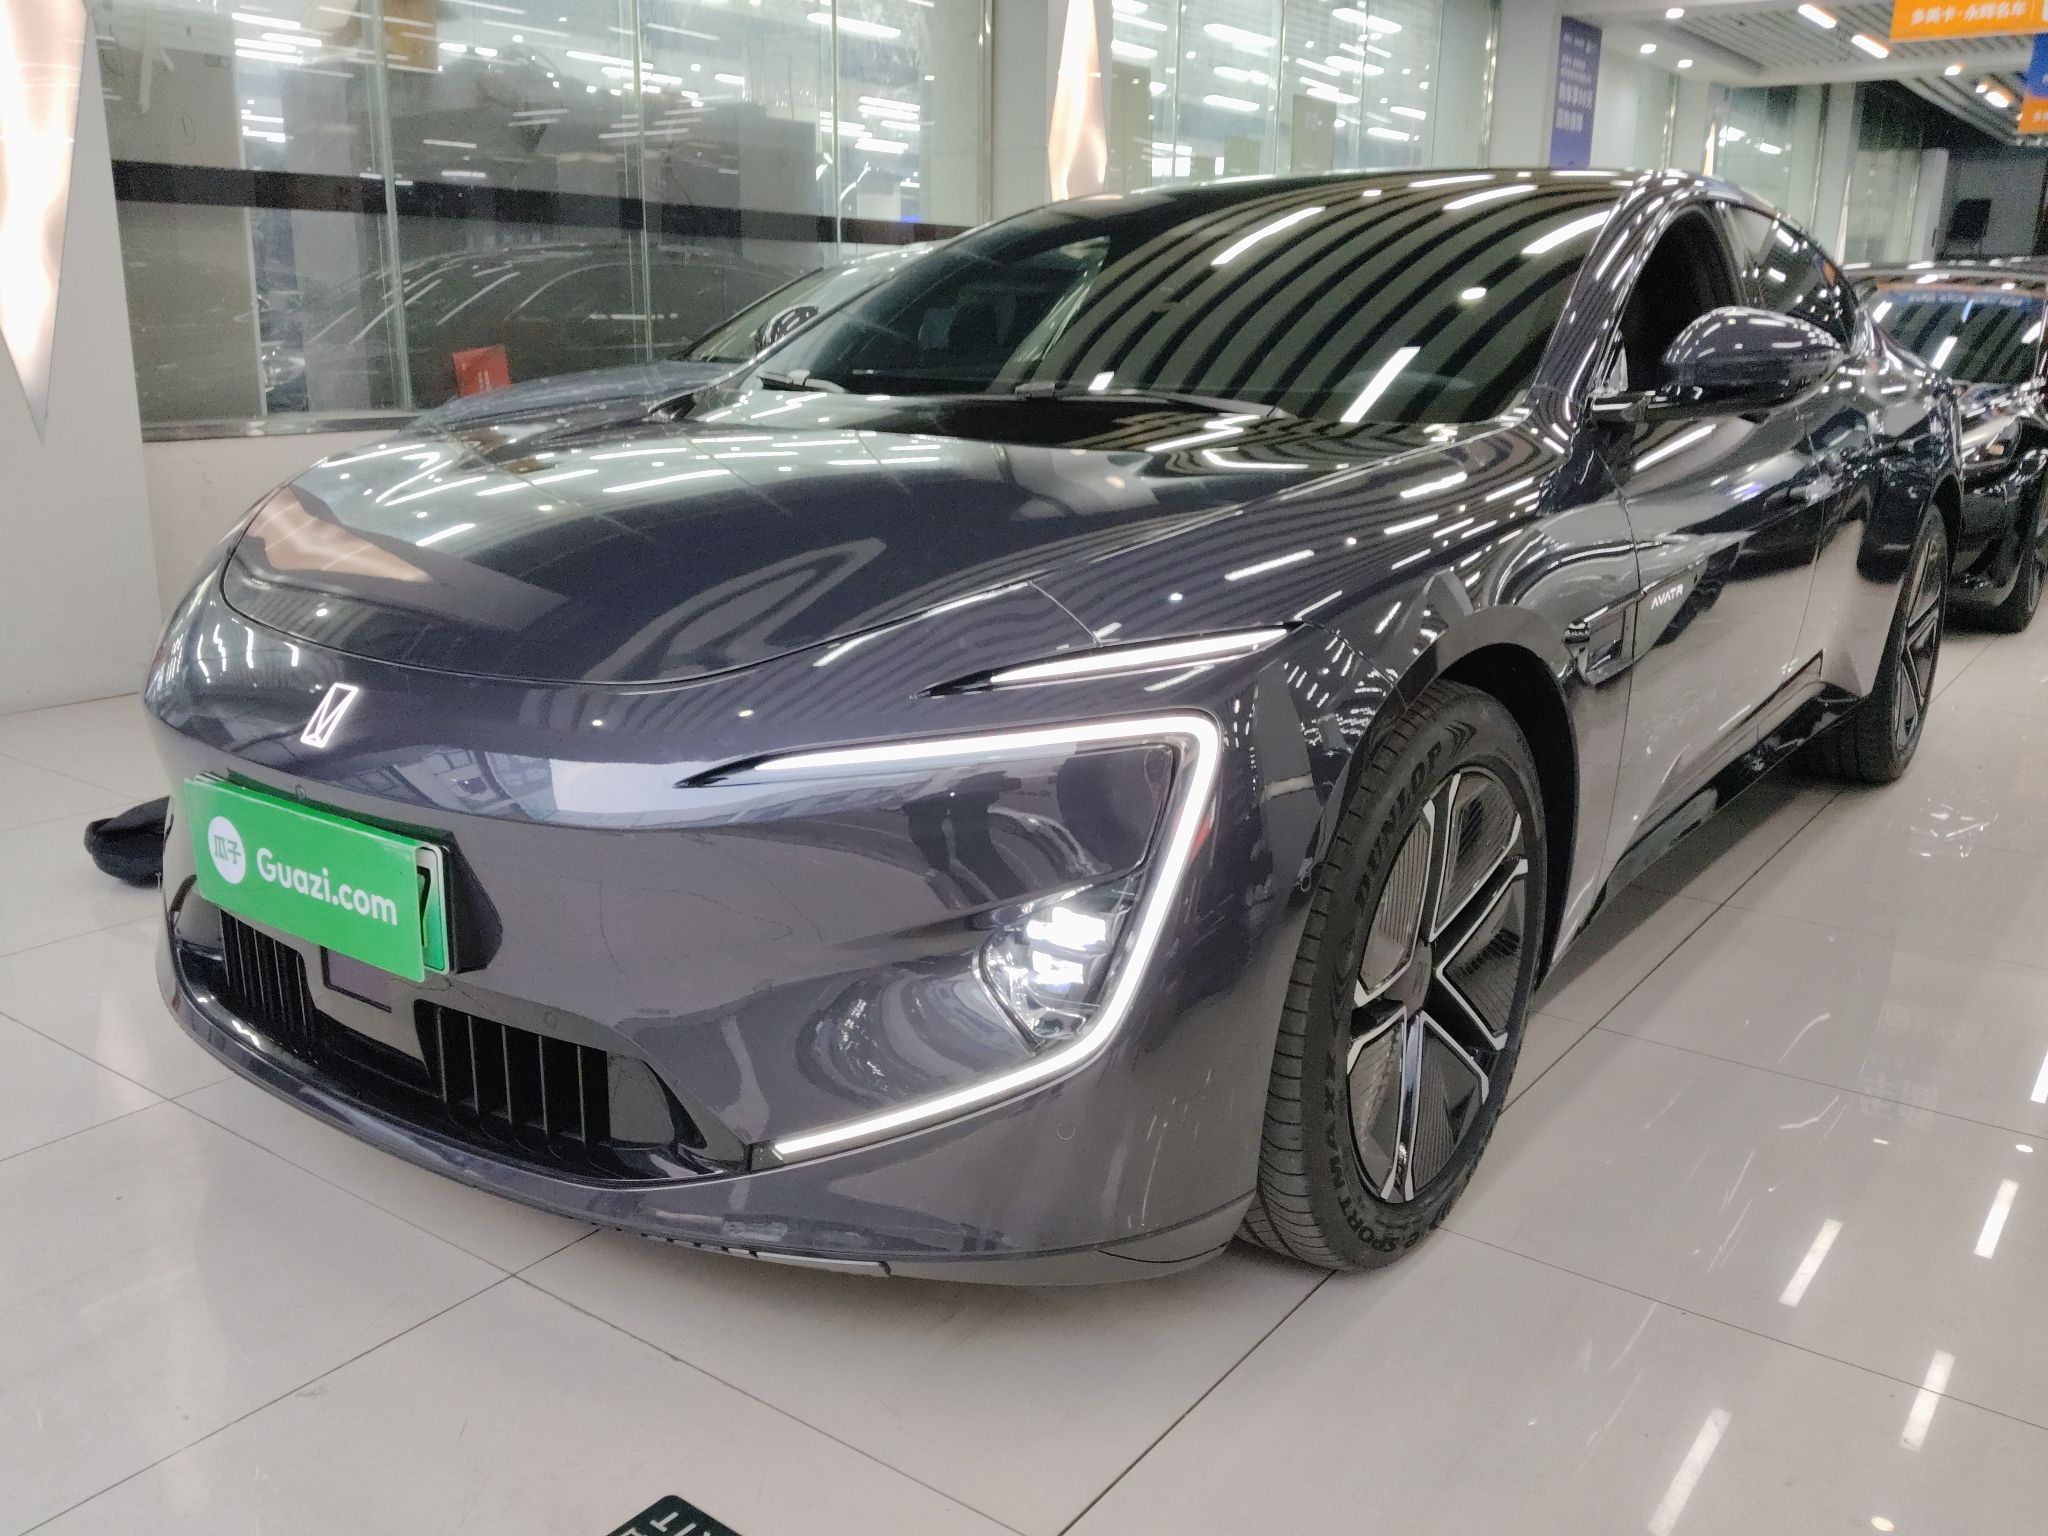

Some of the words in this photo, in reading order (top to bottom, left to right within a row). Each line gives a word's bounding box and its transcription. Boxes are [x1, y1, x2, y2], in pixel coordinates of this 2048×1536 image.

[213, 834, 241, 865] 瓜子
[1356, 741, 1442, 911] DUNLOP
[256, 847, 398, 926] Guazi.com
[1337, 1196, 1400, 1254] SPORT
